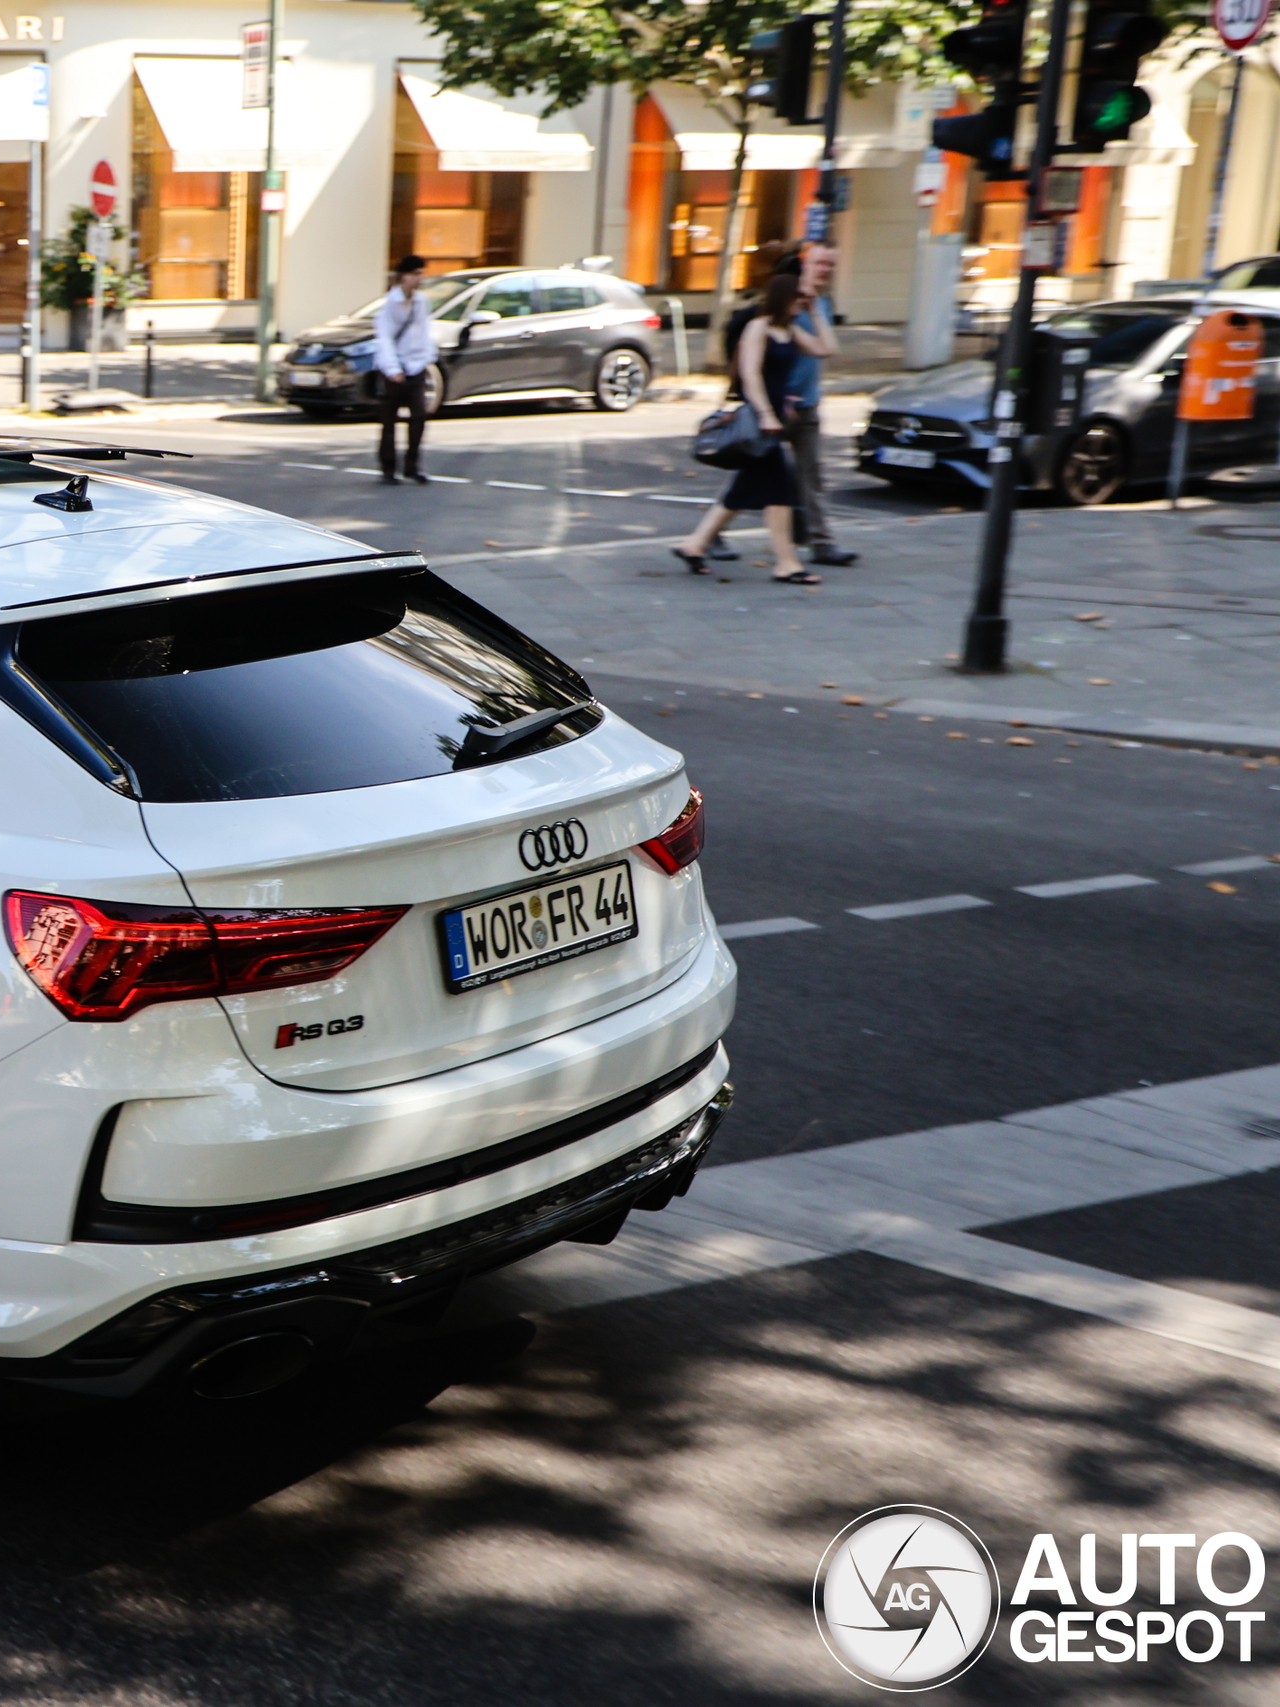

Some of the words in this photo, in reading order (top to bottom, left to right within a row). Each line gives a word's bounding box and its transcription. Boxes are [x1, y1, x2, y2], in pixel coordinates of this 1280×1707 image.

[466, 901, 533, 966] WOR
[547, 885, 590, 942] FR
[595, 873, 629, 926] 44
[454, 954, 464, 969] D
[286, 1022, 324, 1043] RS
[327, 1014, 365, 1036] Q3
